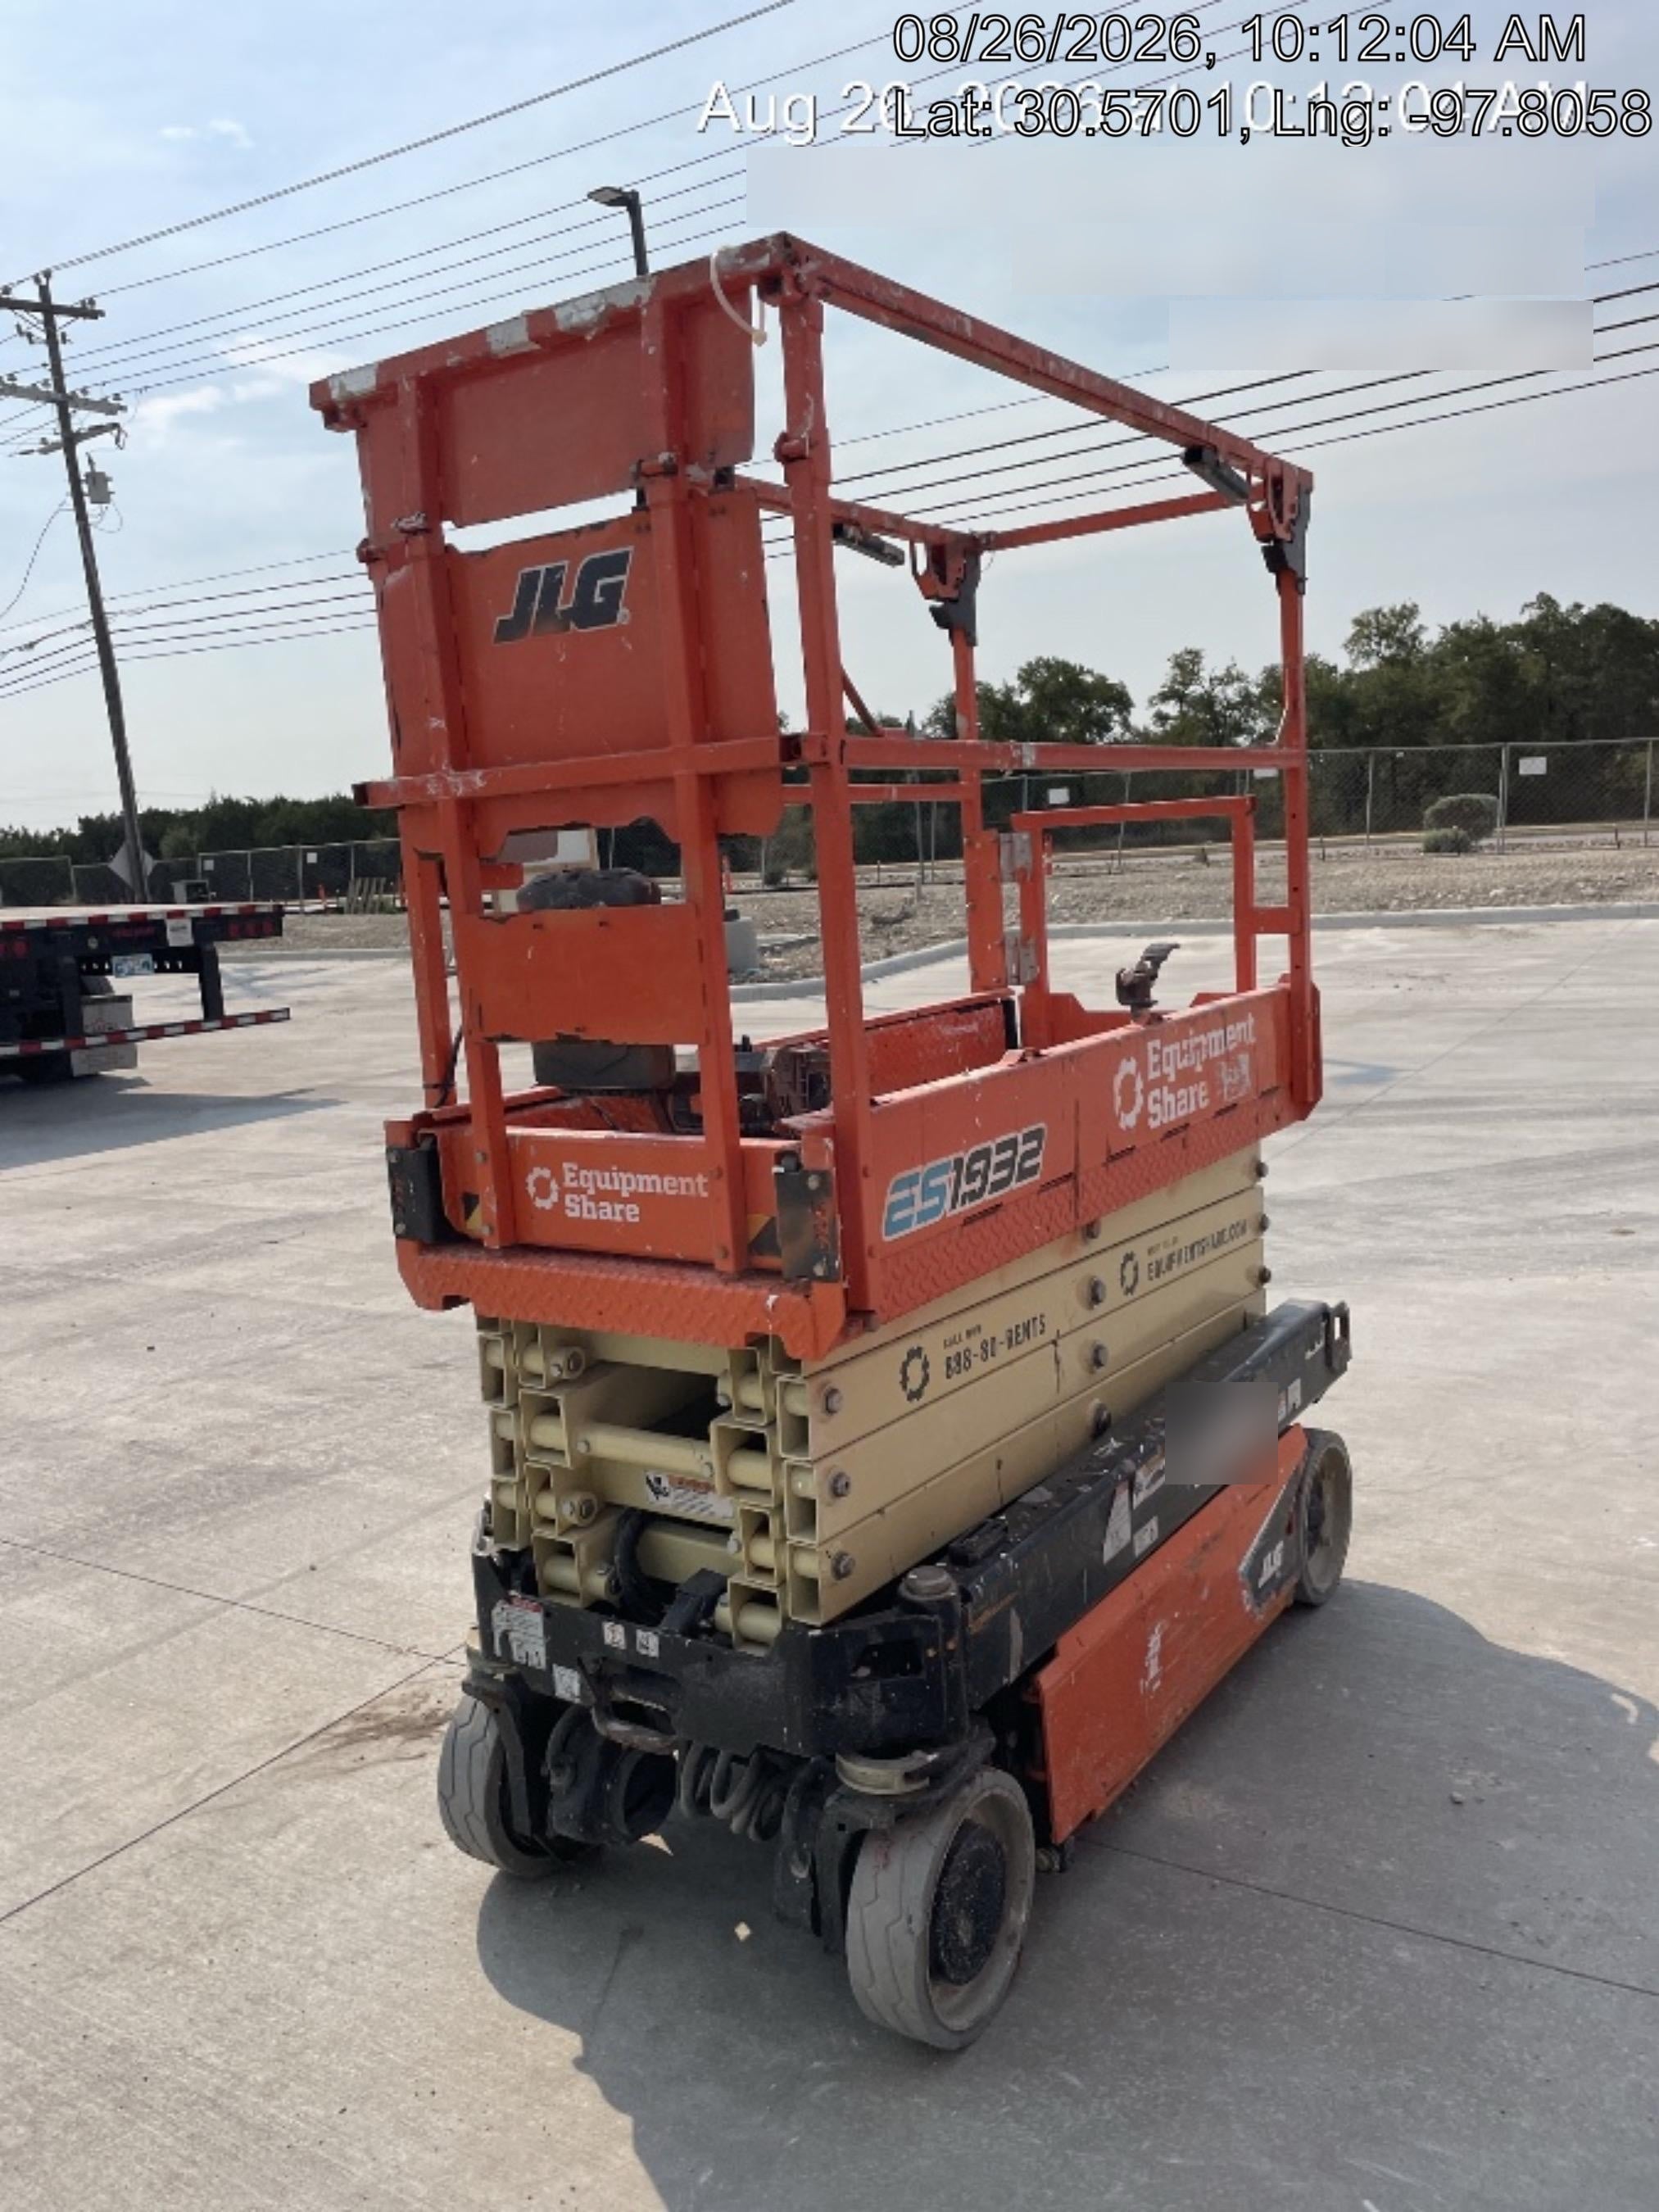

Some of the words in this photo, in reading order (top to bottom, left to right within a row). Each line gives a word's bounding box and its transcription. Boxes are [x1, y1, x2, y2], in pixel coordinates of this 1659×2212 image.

[492, 546, 634, 646] JLG
[1147, 1012, 1256, 1082] Equipment
[1148, 1081, 1210, 1130] Share
[562, 1162, 709, 1198] Equipment
[564, 1194, 641, 1222] Share
[882, 1122, 1047, 1242] ES1932
